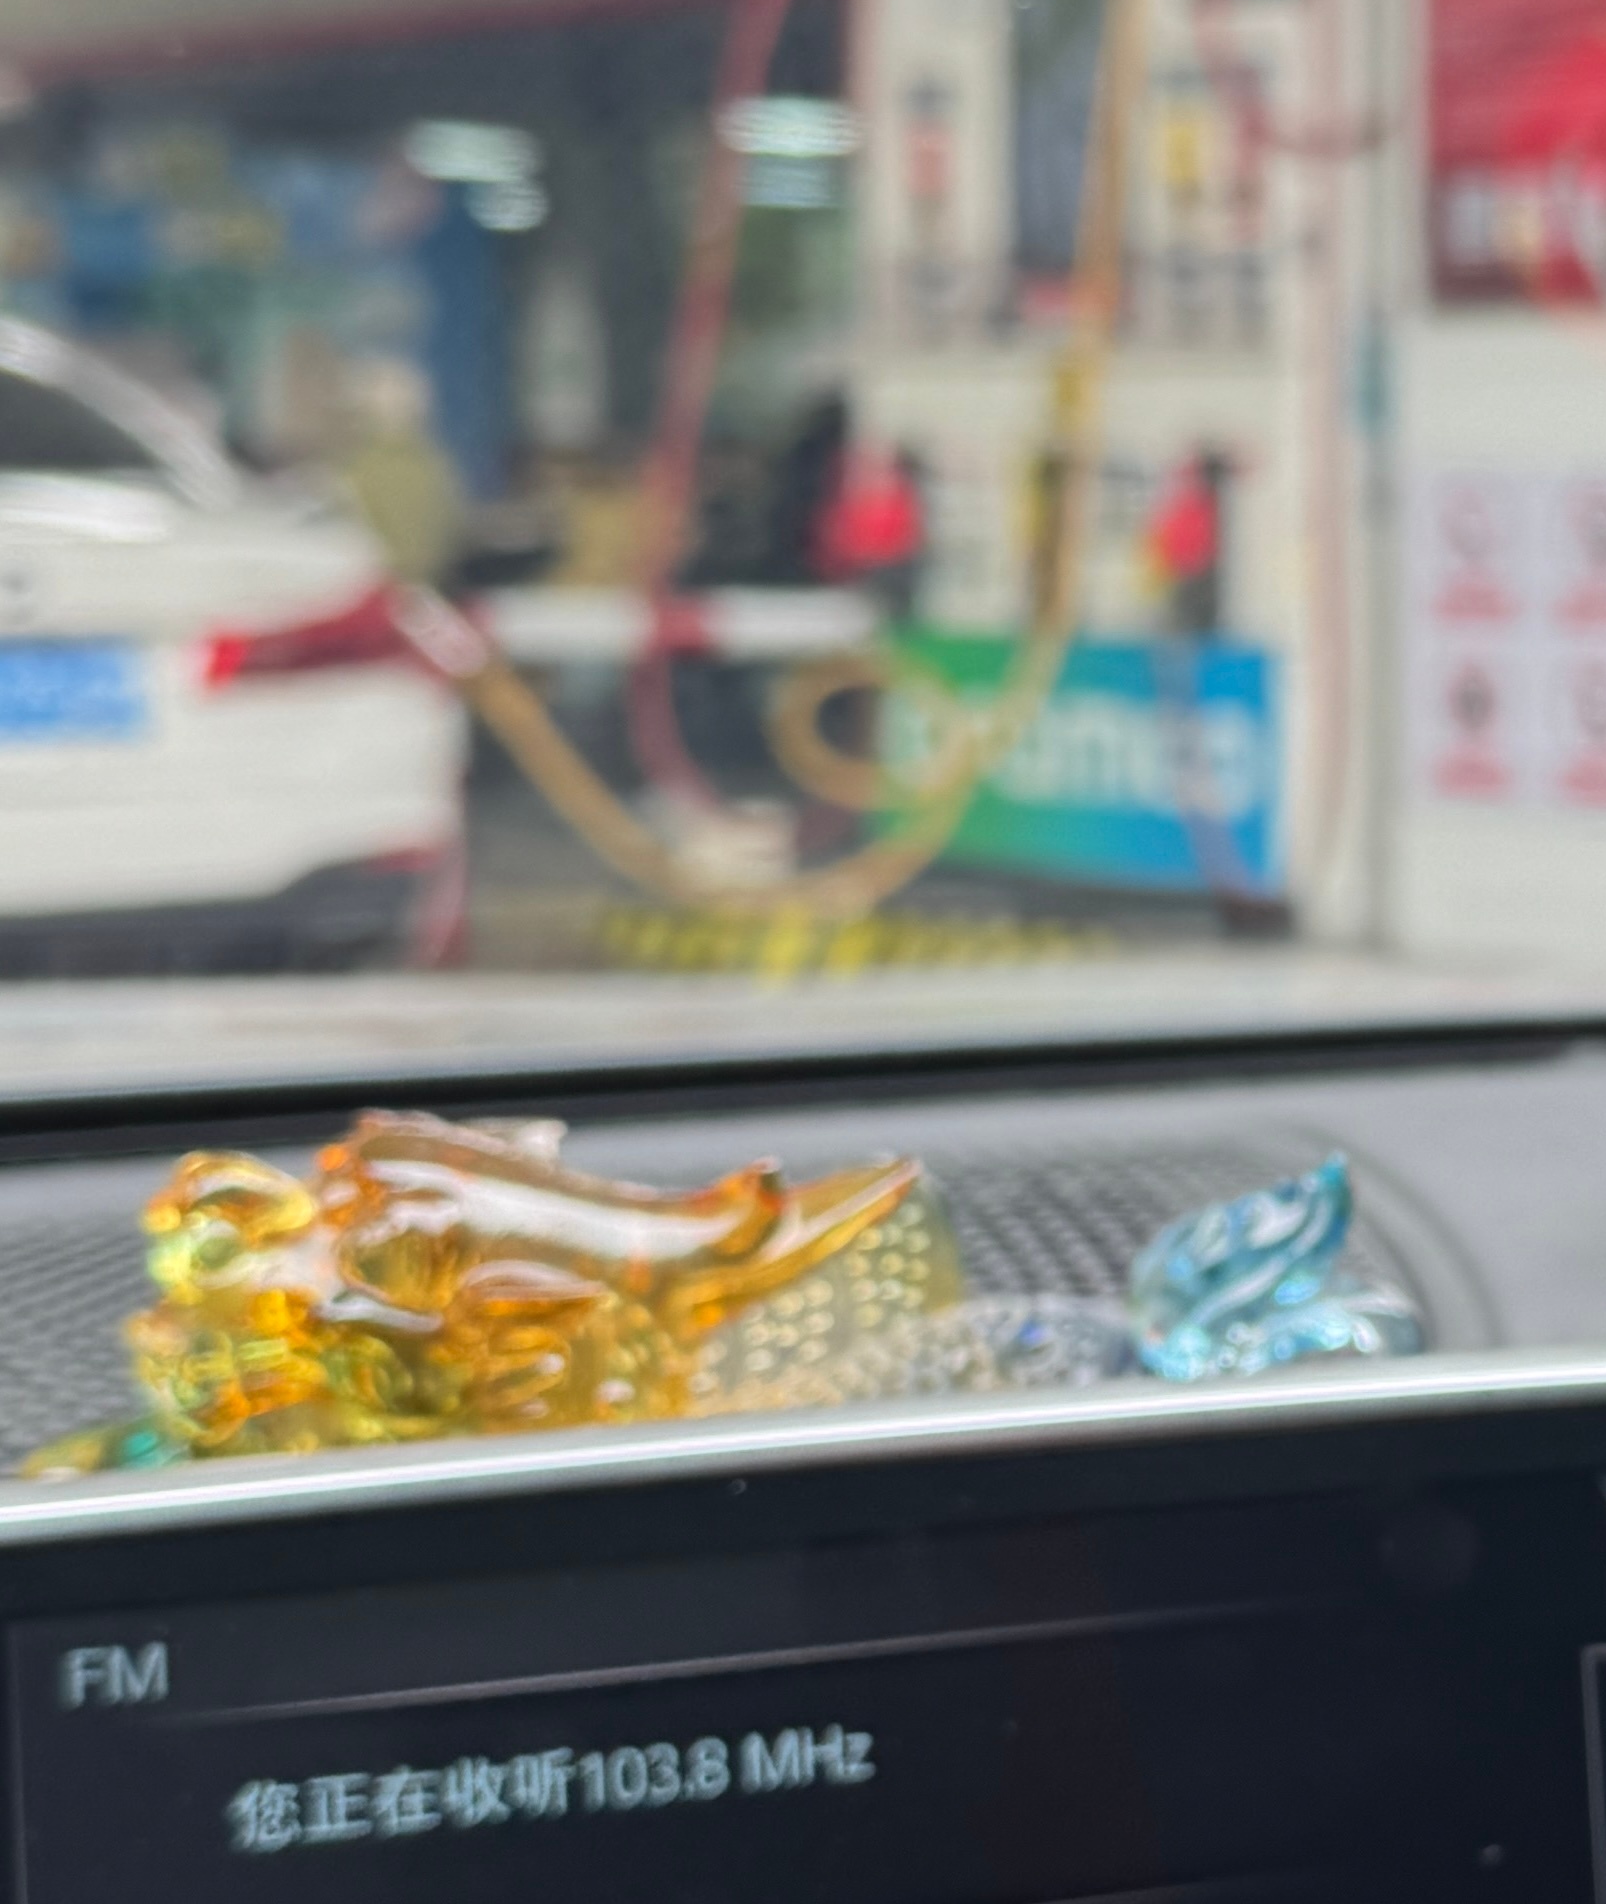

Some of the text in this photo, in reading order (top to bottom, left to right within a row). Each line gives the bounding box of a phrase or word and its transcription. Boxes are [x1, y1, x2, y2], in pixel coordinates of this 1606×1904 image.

[60, 1641, 170, 1709] FM
[225, 1722, 877, 1853] 您正在收听103.8 MHz
